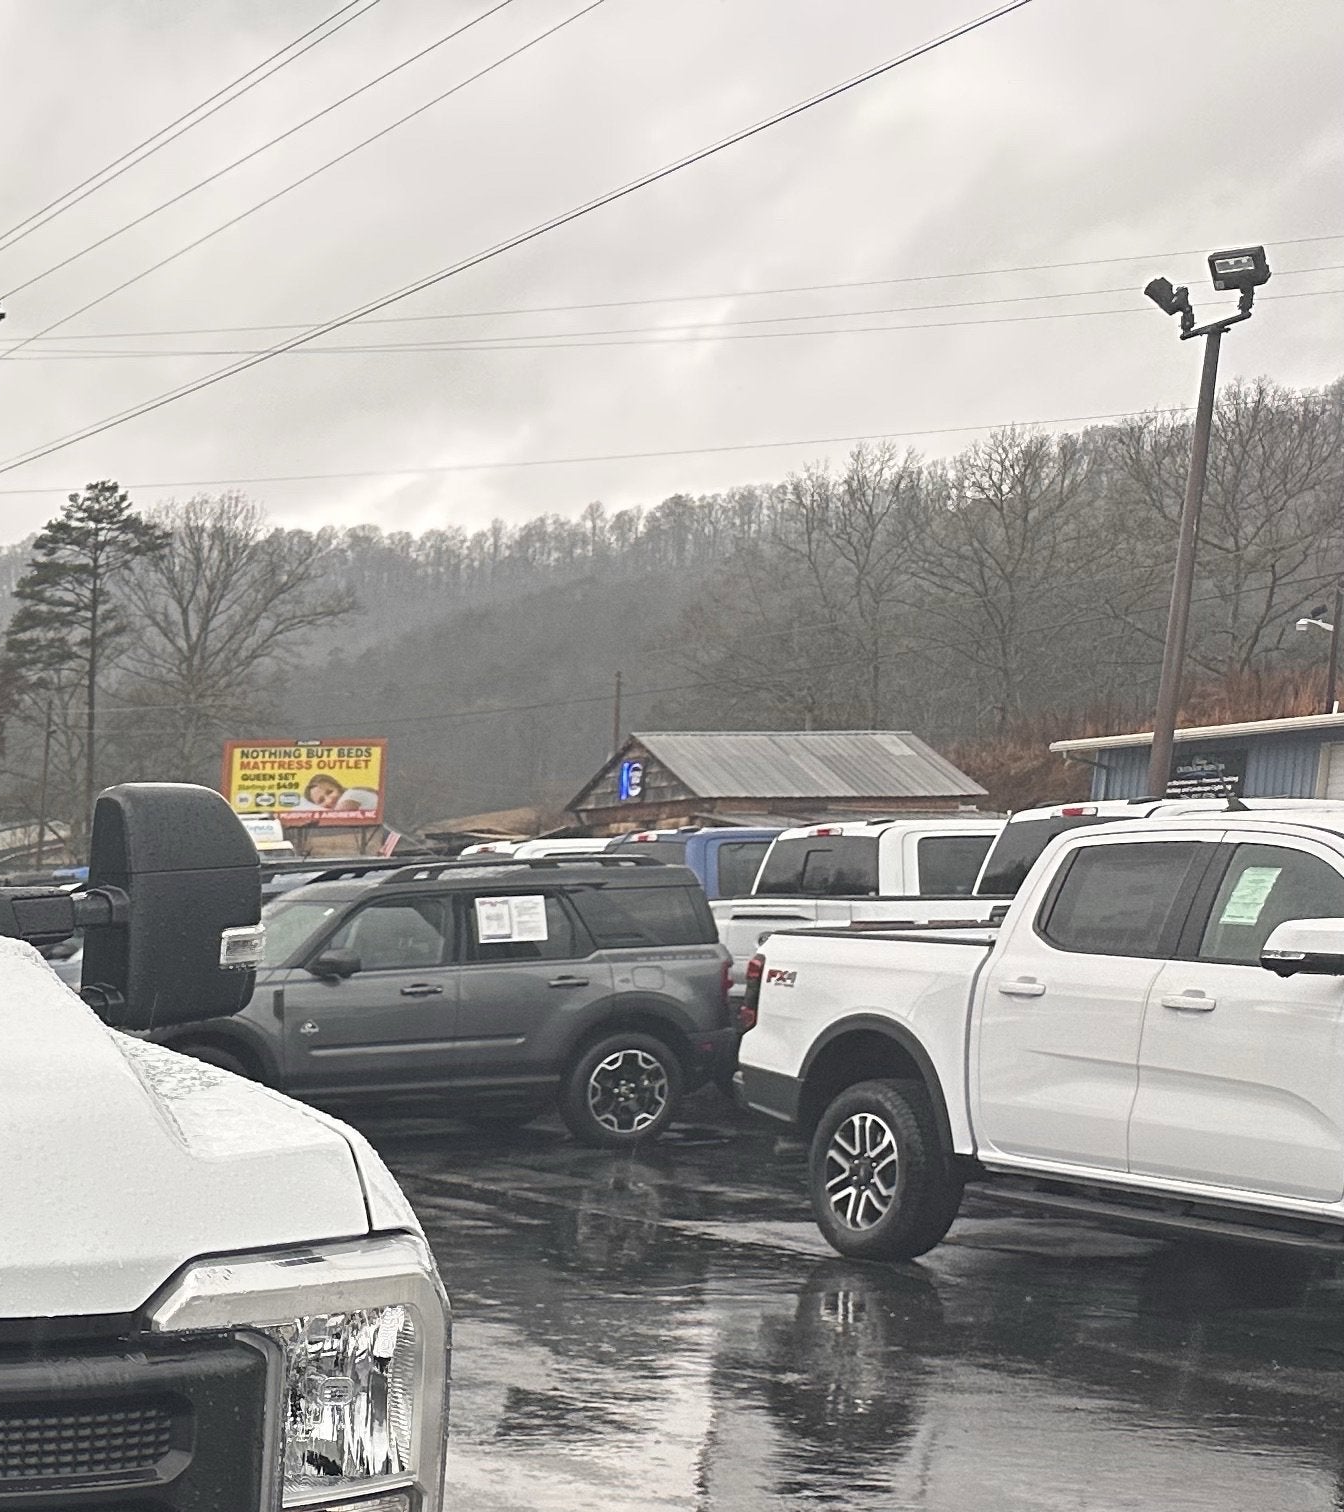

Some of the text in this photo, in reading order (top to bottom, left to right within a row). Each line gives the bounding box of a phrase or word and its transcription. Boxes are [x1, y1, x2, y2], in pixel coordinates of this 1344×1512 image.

[240, 748, 372, 760] NOTHING BUT BEDS
[239, 759, 371, 771] MATTRESS OUTLET
[241, 772, 297, 782] QUEEN SET
[766, 969, 797, 983] FX4
